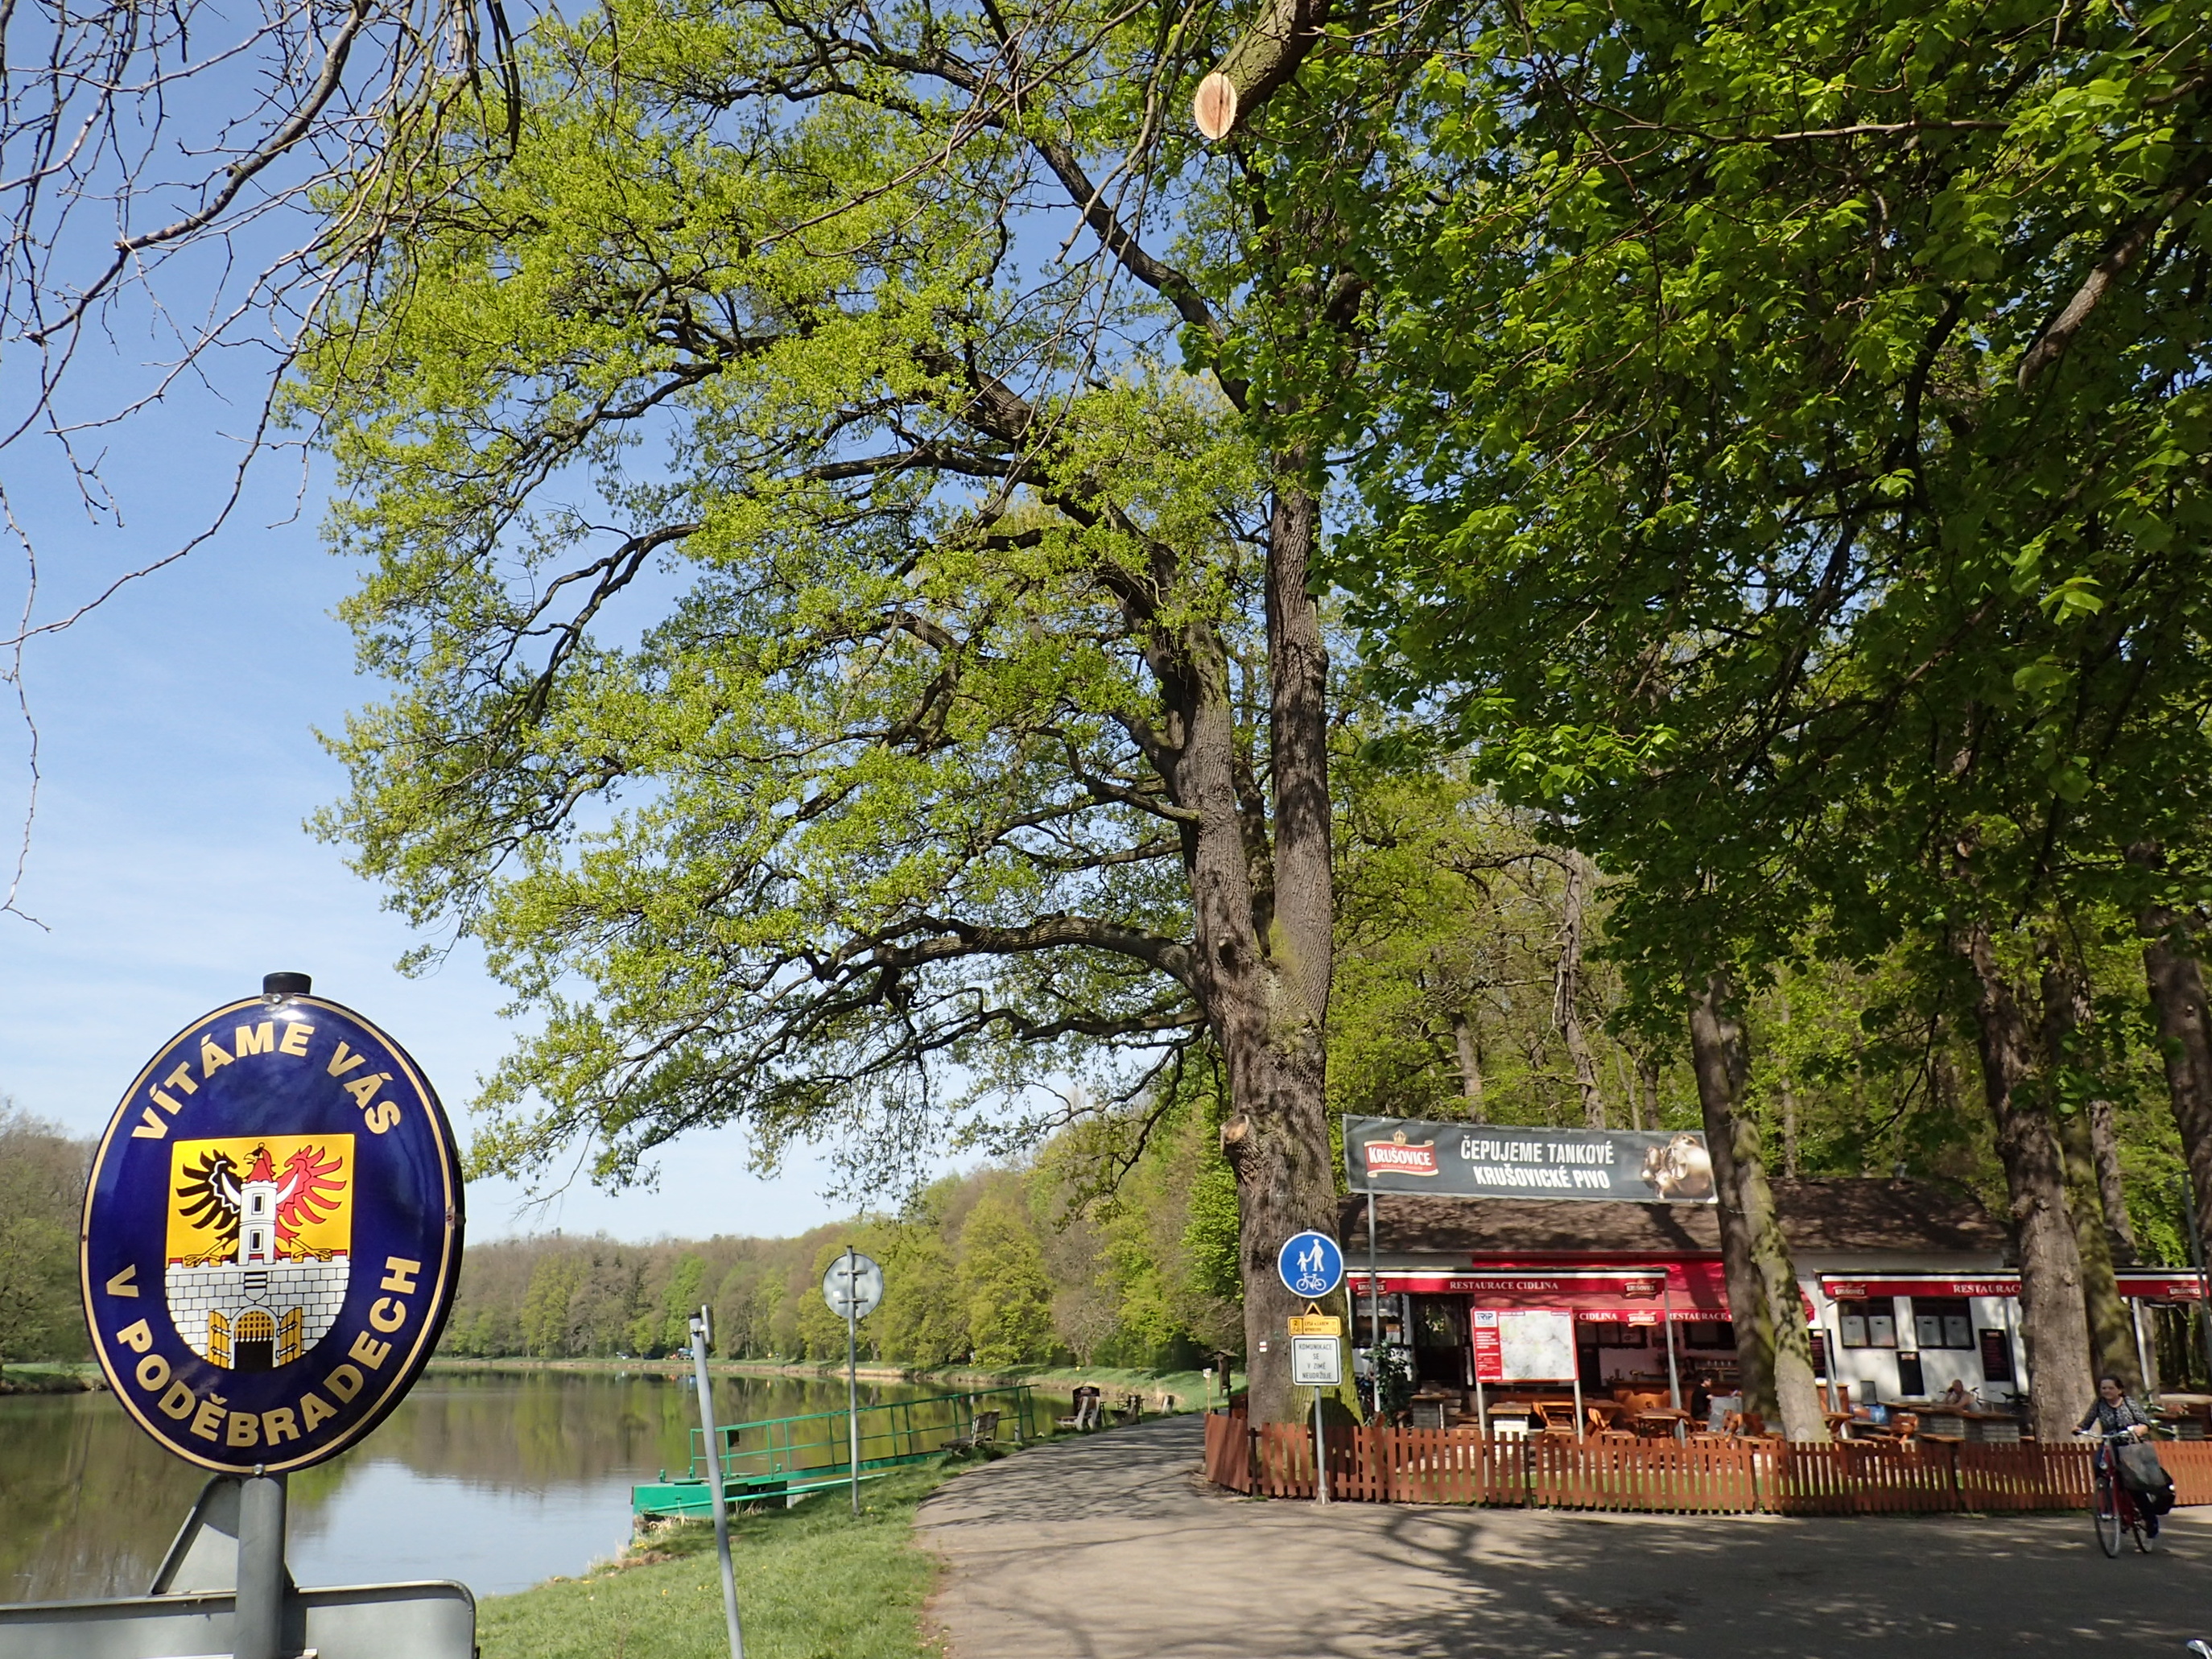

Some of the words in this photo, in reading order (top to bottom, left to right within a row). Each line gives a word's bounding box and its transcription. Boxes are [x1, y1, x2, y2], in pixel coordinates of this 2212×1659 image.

[132, 1021, 315, 1140] VÍTÁME
[327, 1041, 401, 1134] VÁS
[1368, 1147, 1432, 1166] KRUŠOVICE
[1461, 1135, 1542, 1162] ČEPUJEME
[1547, 1141, 1615, 1164] TANKOVÉ
[1473, 1163, 1572, 1188] KRUŠOVICKÉ
[1572, 1170, 1611, 1189] PIVO
[106, 1264, 139, 1298] V
[1450, 1281, 1514, 1290] RESTAURACE
[1516, 1281, 1559, 1290] CIDLINA
[1953, 1284, 2022, 1294] RESTAURAC
[1579, 1312, 1618, 1320] CIDLINA
[117, 1256, 421, 1447] PODĚBRADECH
[1302, 1371, 1332, 1380] NEUDRŽUJE
